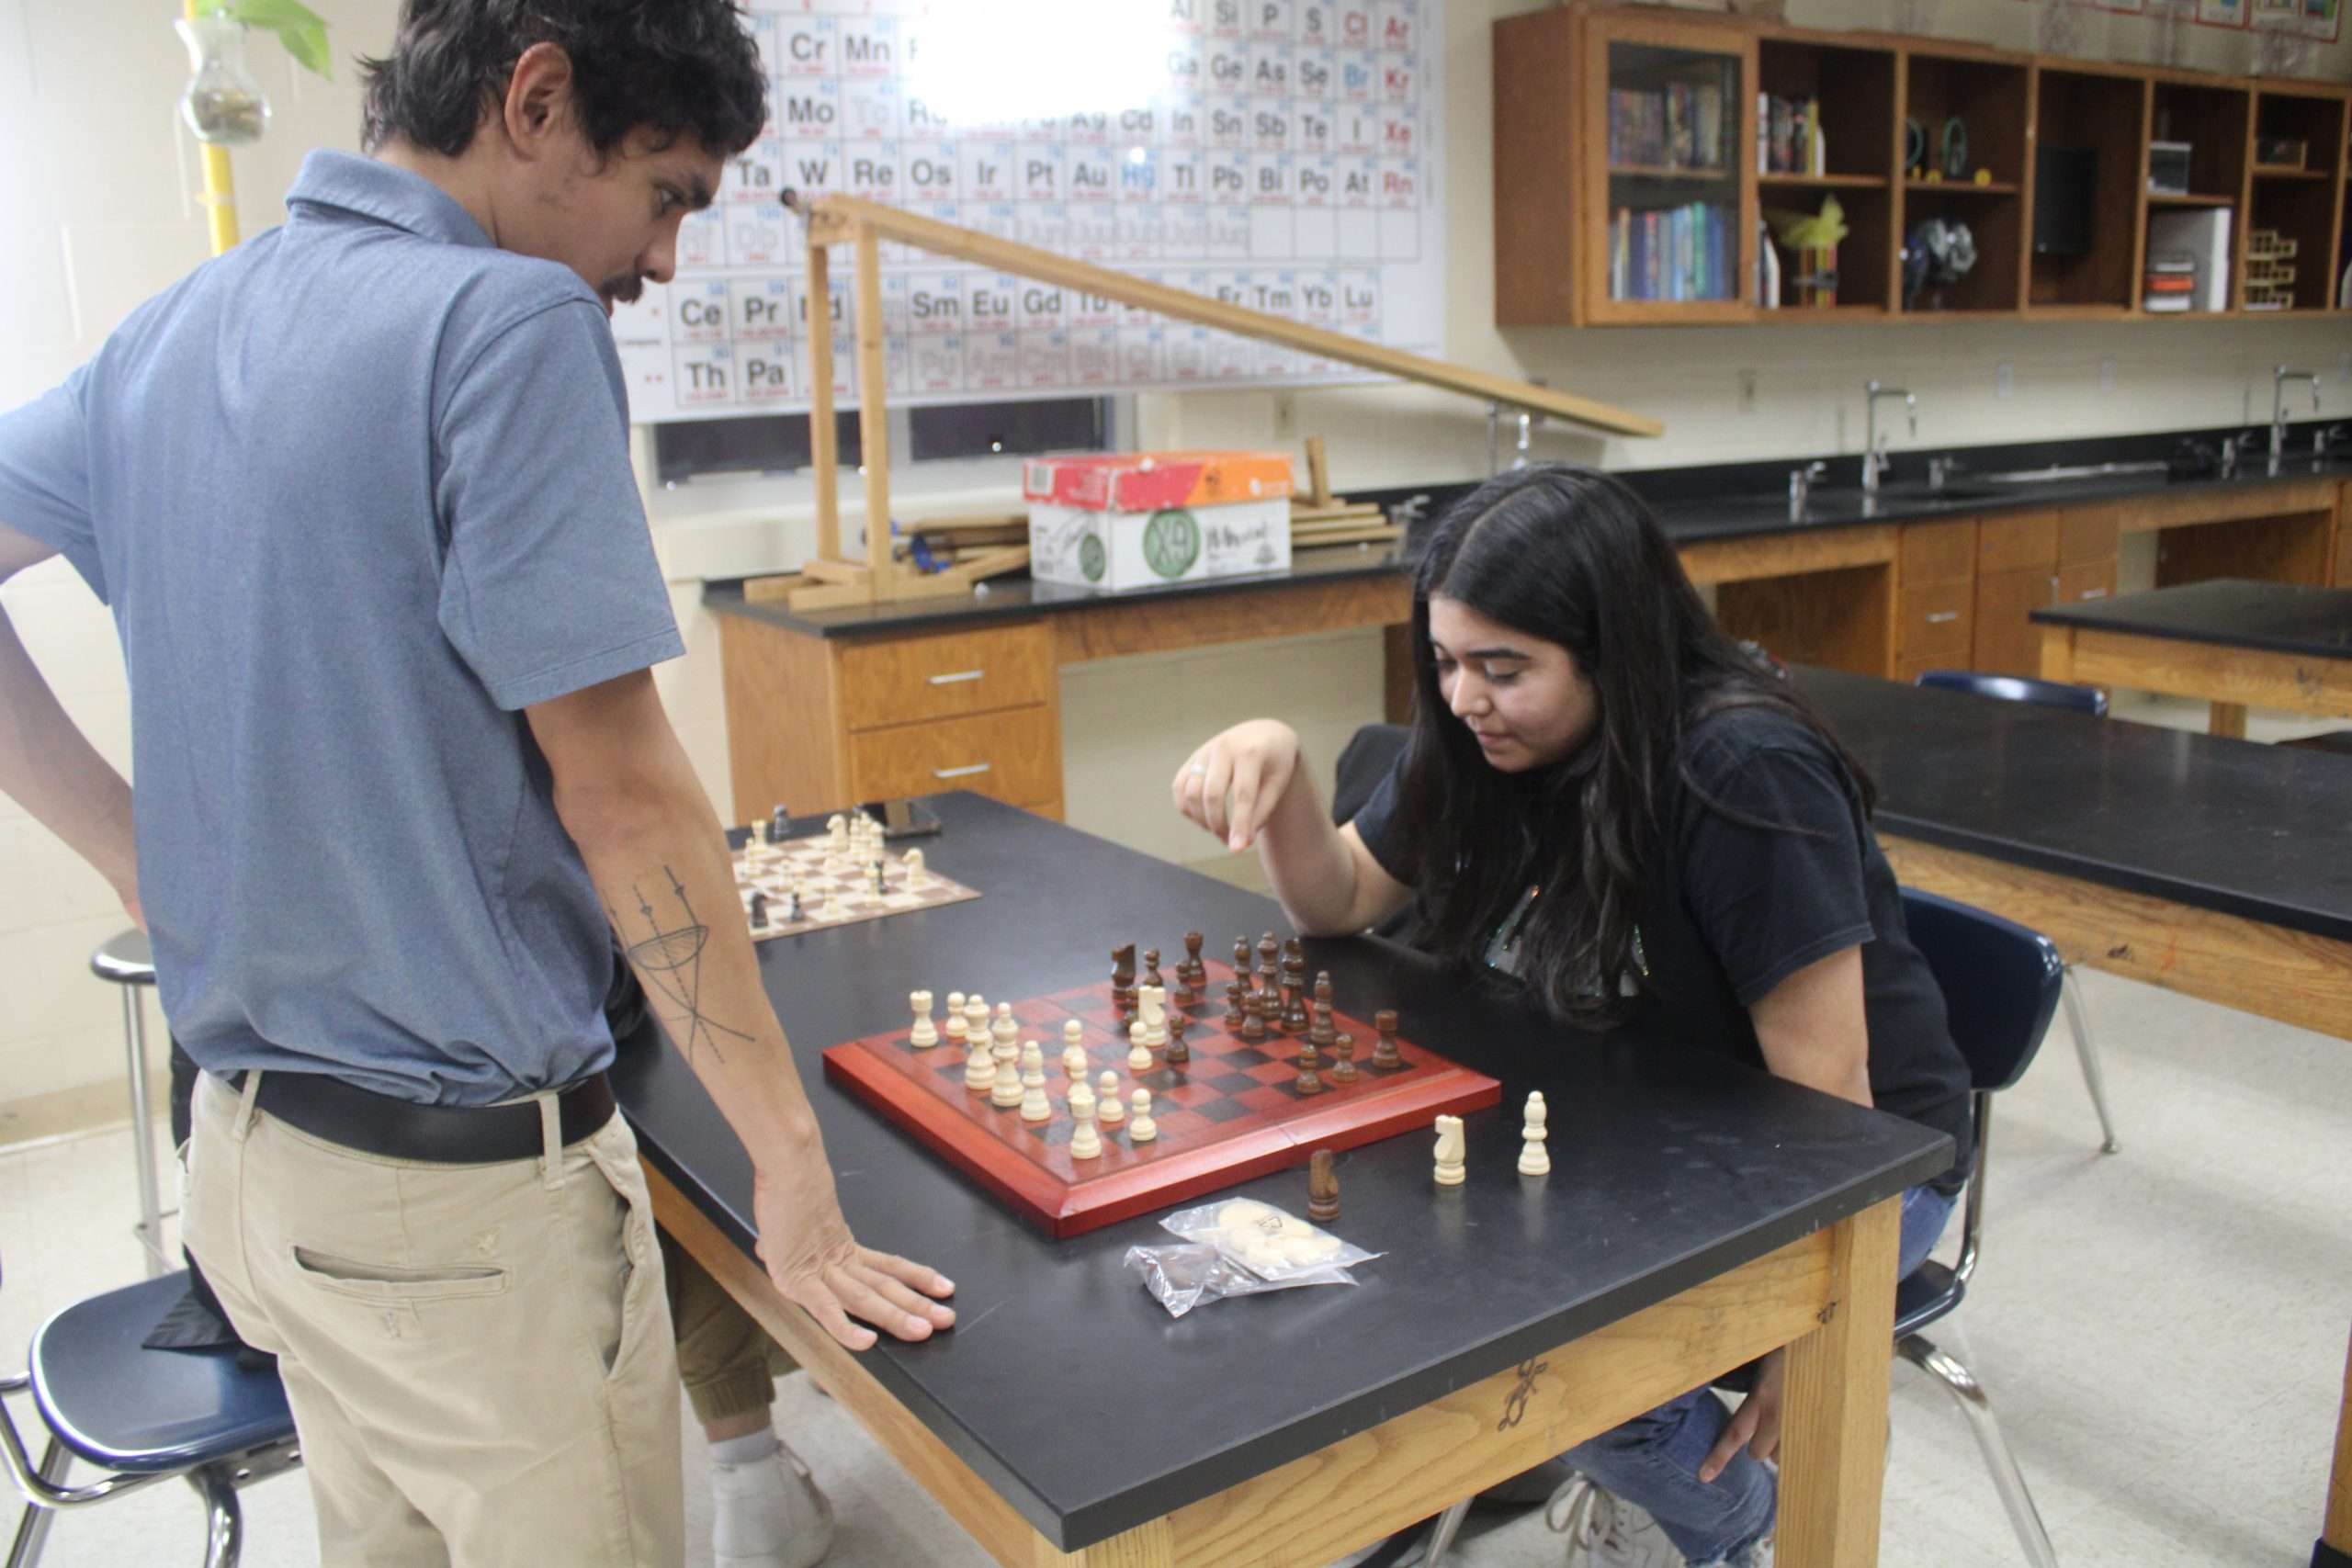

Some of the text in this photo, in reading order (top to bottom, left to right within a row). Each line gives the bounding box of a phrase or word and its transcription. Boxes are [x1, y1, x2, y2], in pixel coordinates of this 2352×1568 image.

[1215, 1, 1238, 25] Si
[1262, 5, 1278, 27] P
[1306, 7, 1323, 32] S
[790, 33, 826, 62] Cr
[845, 36, 891, 62] Mn
[1212, 54, 1243, 80] Ge
[1300, 61, 1329, 85] Se
[788, 97, 834, 124] Mo
[1120, 109, 1154, 132] Cd
[1213, 109, 1243, 135] Sn
[1255, 112, 1286, 138] Sb
[1303, 115, 1329, 140] Te
[737, 159, 772, 186] Ta
[797, 159, 829, 185] W
[854, 159, 894, 186] Re
[910, 159, 953, 186] Os
[978, 158, 998, 186] Ir
[1026, 159, 1054, 186] Pt
[1073, 162, 1108, 186] Au
[1213, 166, 1244, 191] Pb
[1260, 168, 1284, 192] Bi
[1299, 170, 1329, 194] Po
[680, 299, 722, 327] Ce
[744, 296, 779, 323] Pr
[912, 290, 960, 319] Sm
[972, 289, 1010, 316] Eu
[1023, 288, 1062, 314] Gd
[1256, 287, 1292, 310] Tm
[1303, 288, 1333, 310] Yb
[1345, 287, 1374, 310] Lu
[684, 363, 725, 390] Th
[747, 359, 785, 386] Pa
